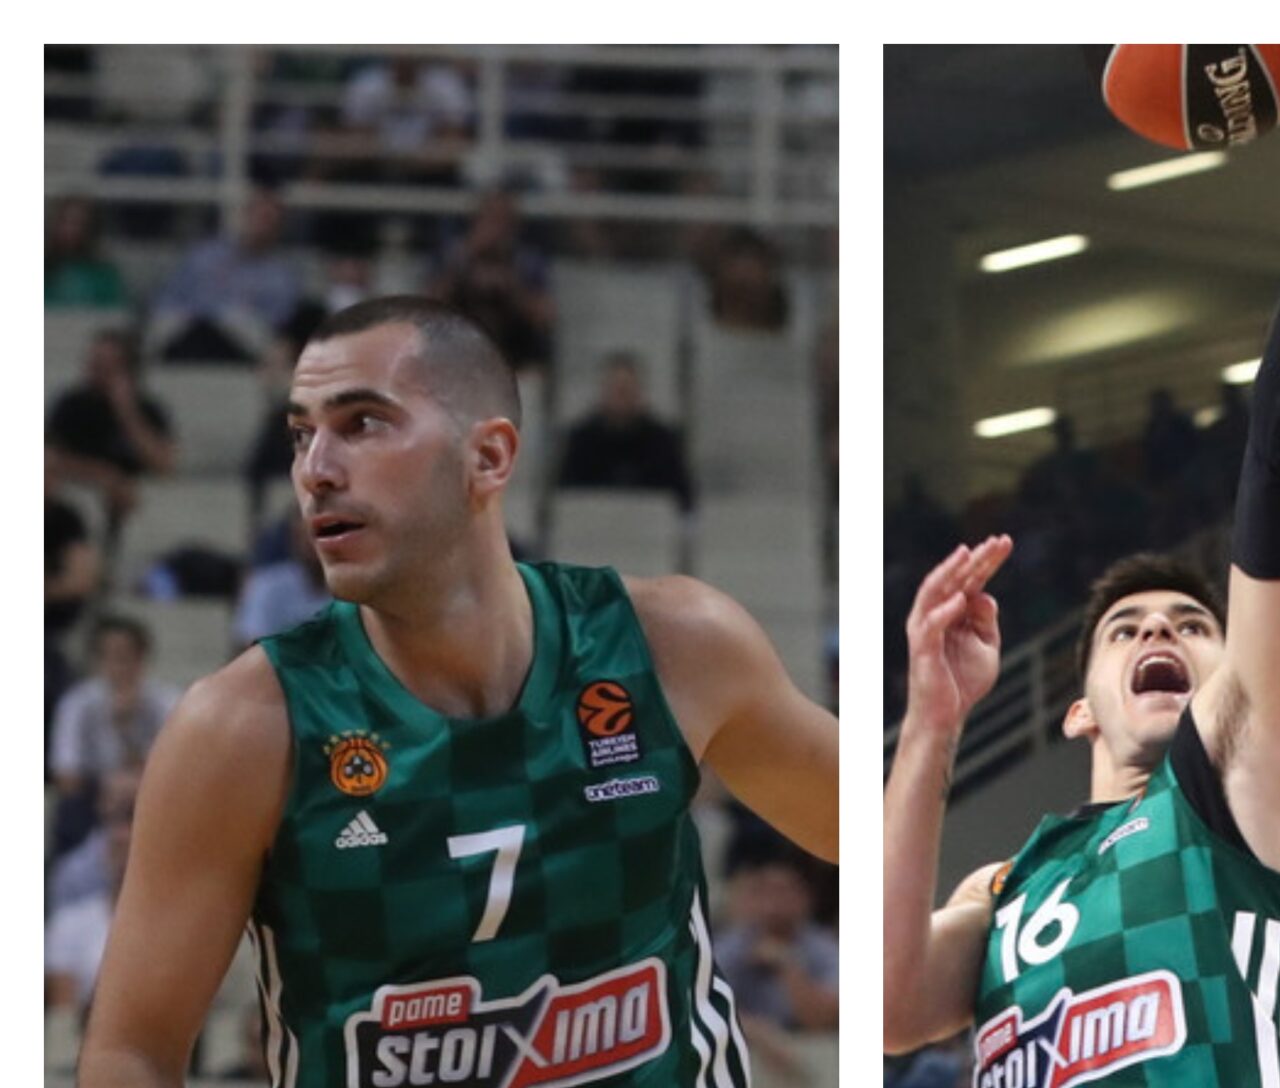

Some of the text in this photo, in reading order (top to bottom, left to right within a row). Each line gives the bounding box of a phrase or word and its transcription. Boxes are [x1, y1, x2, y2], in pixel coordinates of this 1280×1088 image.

[335, 831, 388, 849] adidas
[447, 825, 526, 943] 7
[995, 878, 1081, 983] 16
[388, 990, 463, 1026] pame
